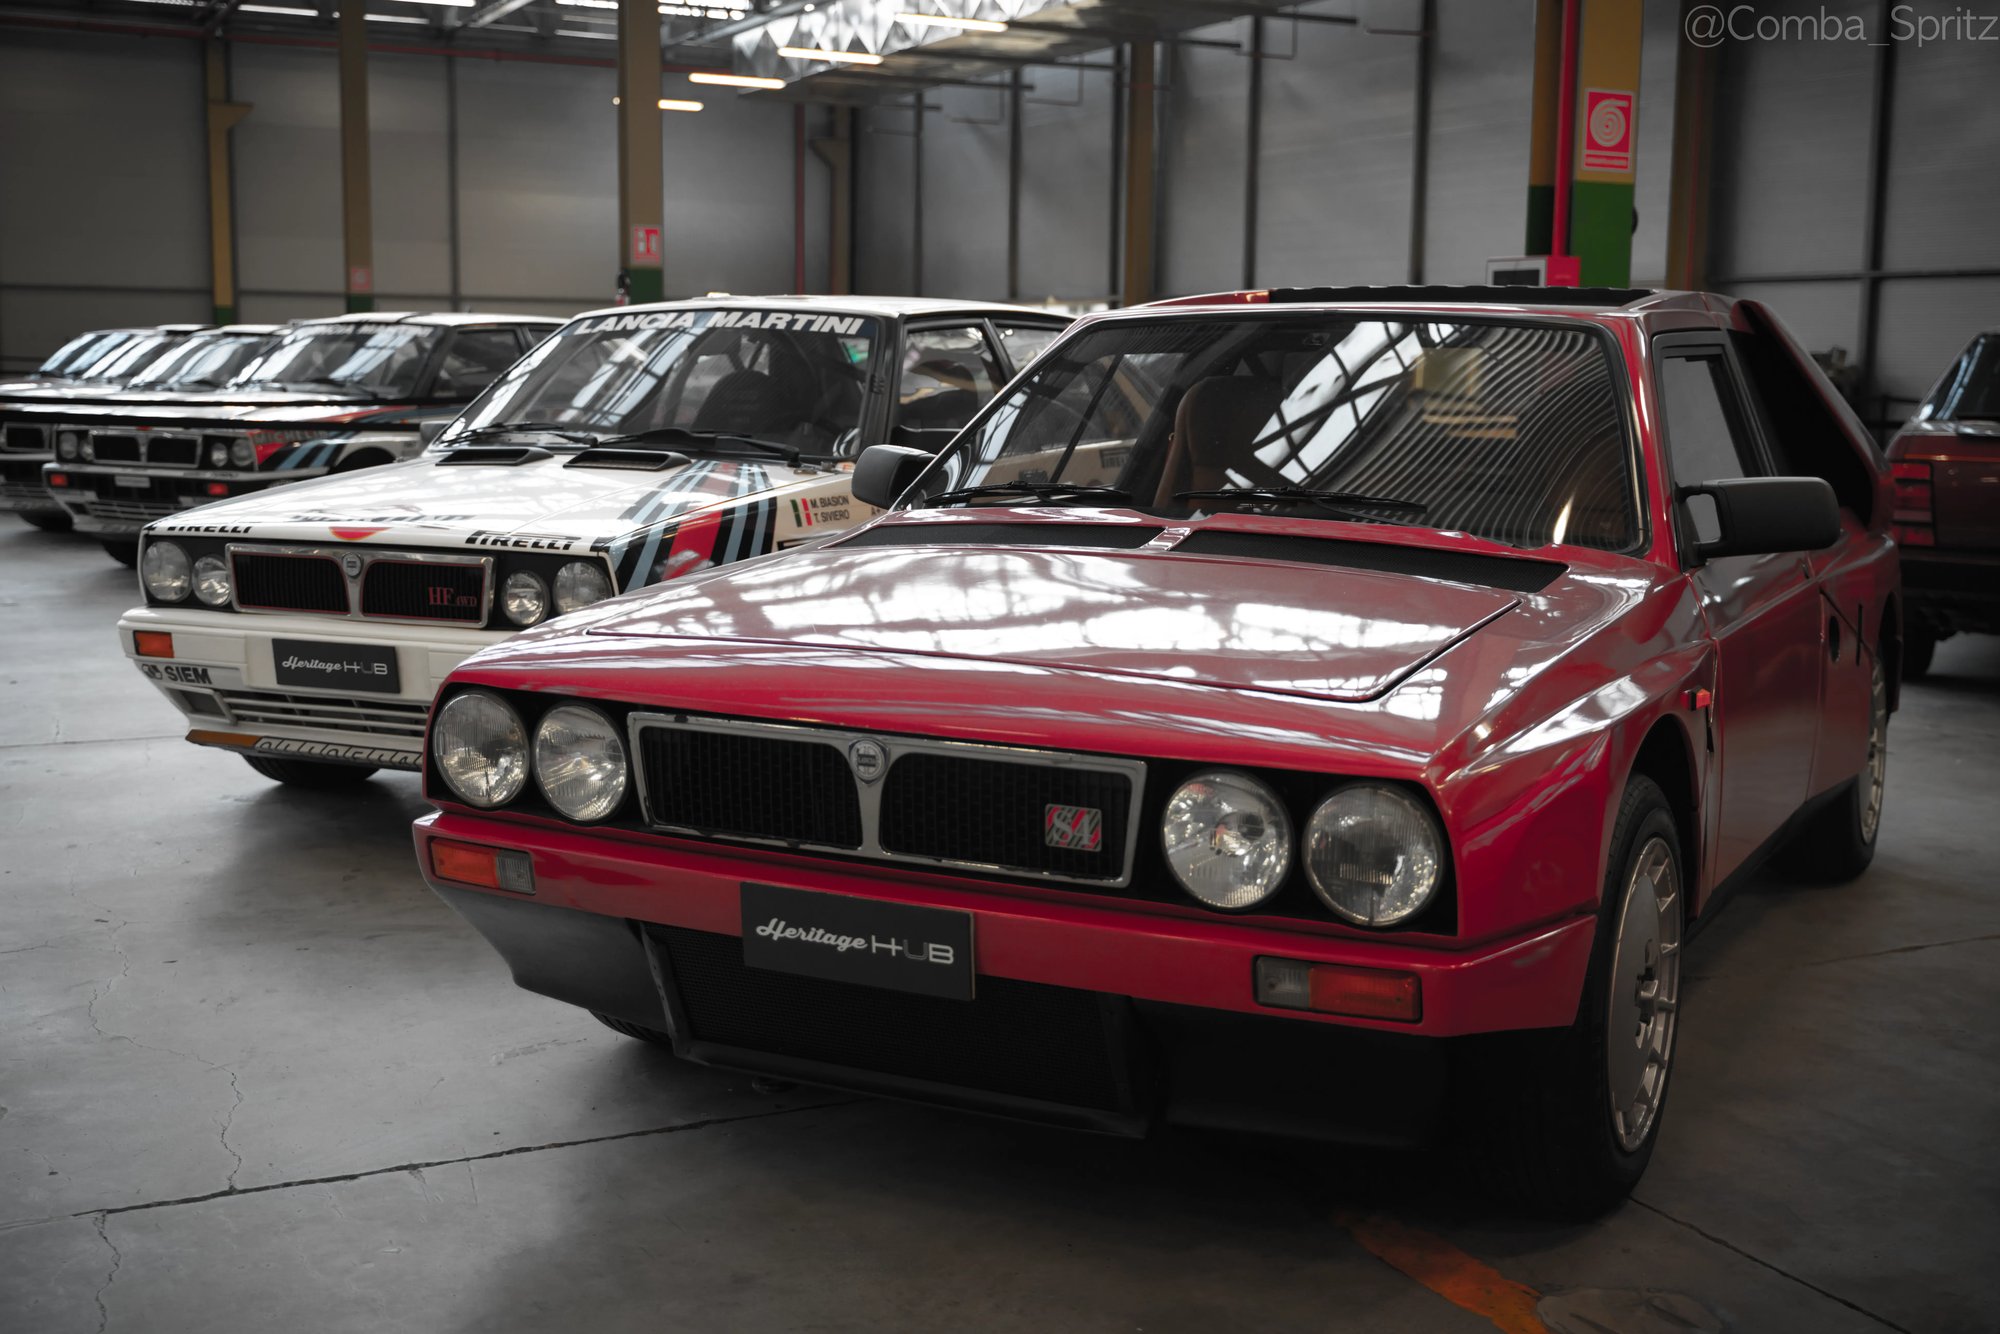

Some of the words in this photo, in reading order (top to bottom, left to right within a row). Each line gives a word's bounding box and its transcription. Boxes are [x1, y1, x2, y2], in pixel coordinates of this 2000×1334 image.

[573, 312, 696, 335] LANCIA
[704, 311, 867, 335] MARTINI
[819, 495, 850, 508] BIASION
[821, 510, 850, 523] SIVIERO
[465, 530, 582, 551] PIRELLI
[281, 655, 344, 674] Heritage
[343, 660, 389, 675] HUB
[163, 666, 213, 685] SIEM
[1053, 810, 1092, 845] S4
[756, 918, 868, 952] Heritage
[871, 935, 955, 964] HUB
